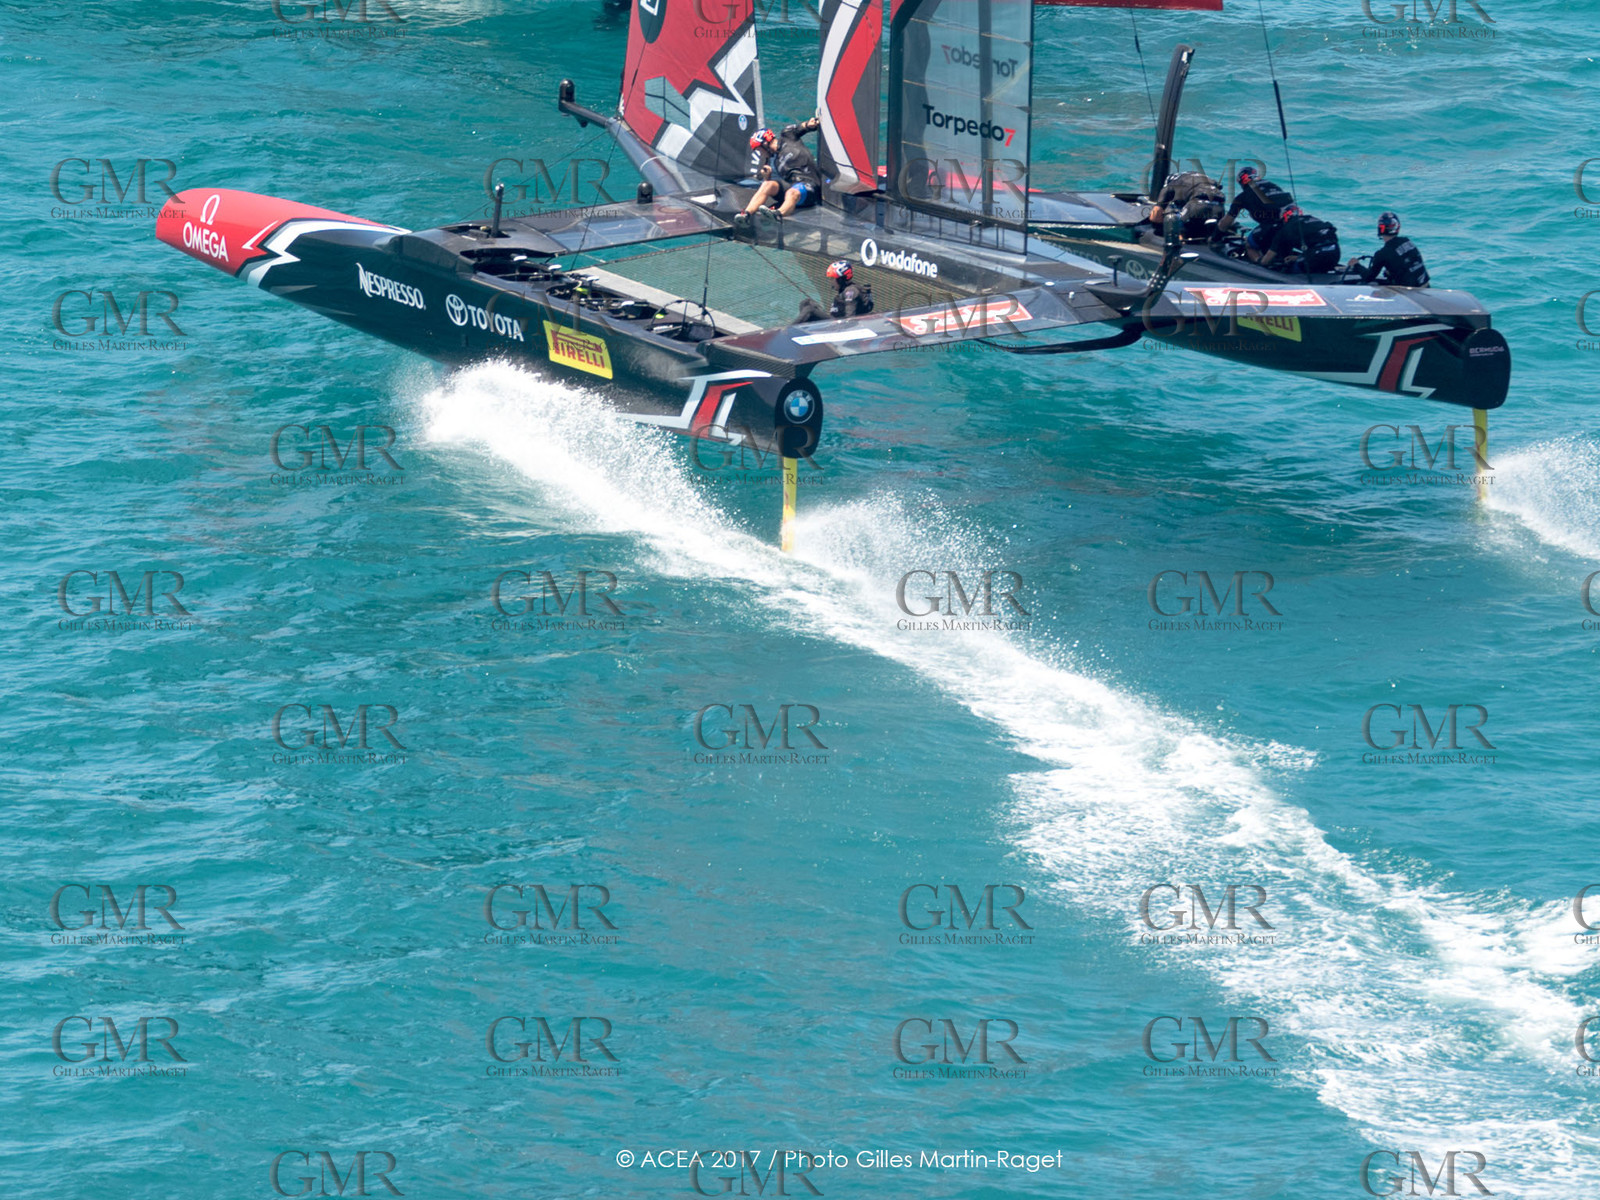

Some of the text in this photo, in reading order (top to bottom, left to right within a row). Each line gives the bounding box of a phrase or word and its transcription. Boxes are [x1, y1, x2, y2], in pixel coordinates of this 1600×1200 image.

[922, 103, 1016, 147] Torpedo7
[182, 221, 229, 263] OMEGA
[880, 249, 938, 279] vodafone
[355, 261, 425, 310] NESPRESSO
[467, 304, 525, 342] TOYOTA
[551, 329, 606, 369] PIRELLI
